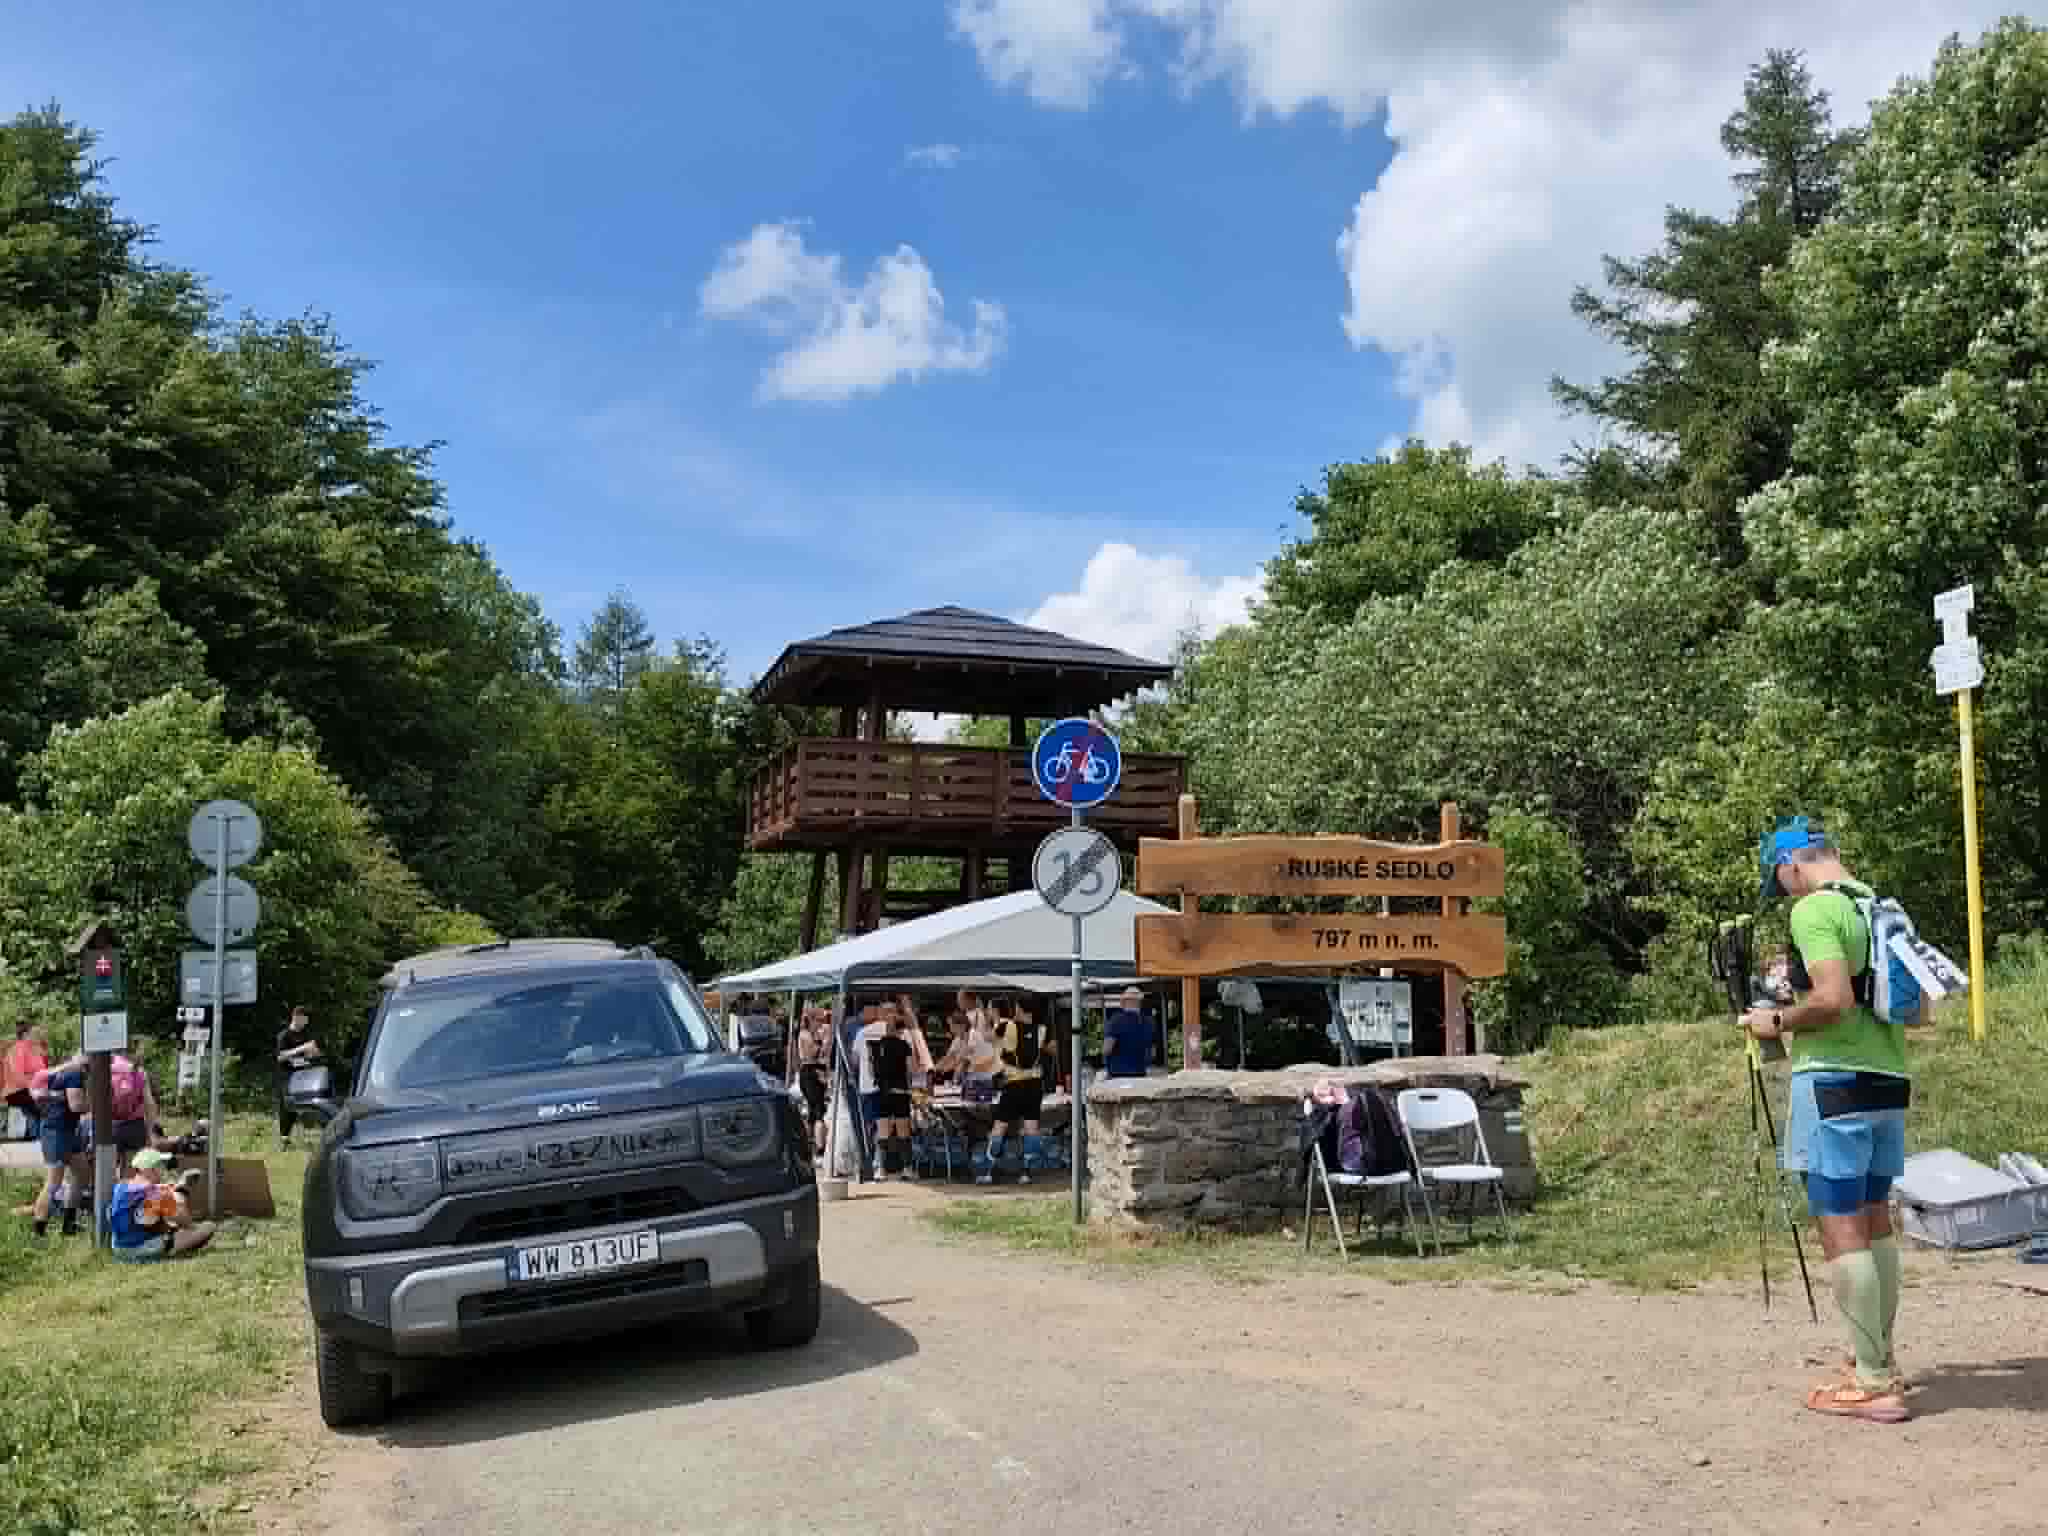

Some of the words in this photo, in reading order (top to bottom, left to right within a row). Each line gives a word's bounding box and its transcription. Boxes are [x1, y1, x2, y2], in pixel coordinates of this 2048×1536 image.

[1287, 856, 1369, 879] RUSKÉ
[1375, 860, 1455, 880] SEDLO
[1312, 928, 1352, 949] 797
[1359, 934, 1378, 949] m
[1385, 934, 1406, 949] n.
[1413, 934, 1439, 949] m.
[527, 1246, 560, 1276] WW
[570, 1232, 650, 1268] 813UF
